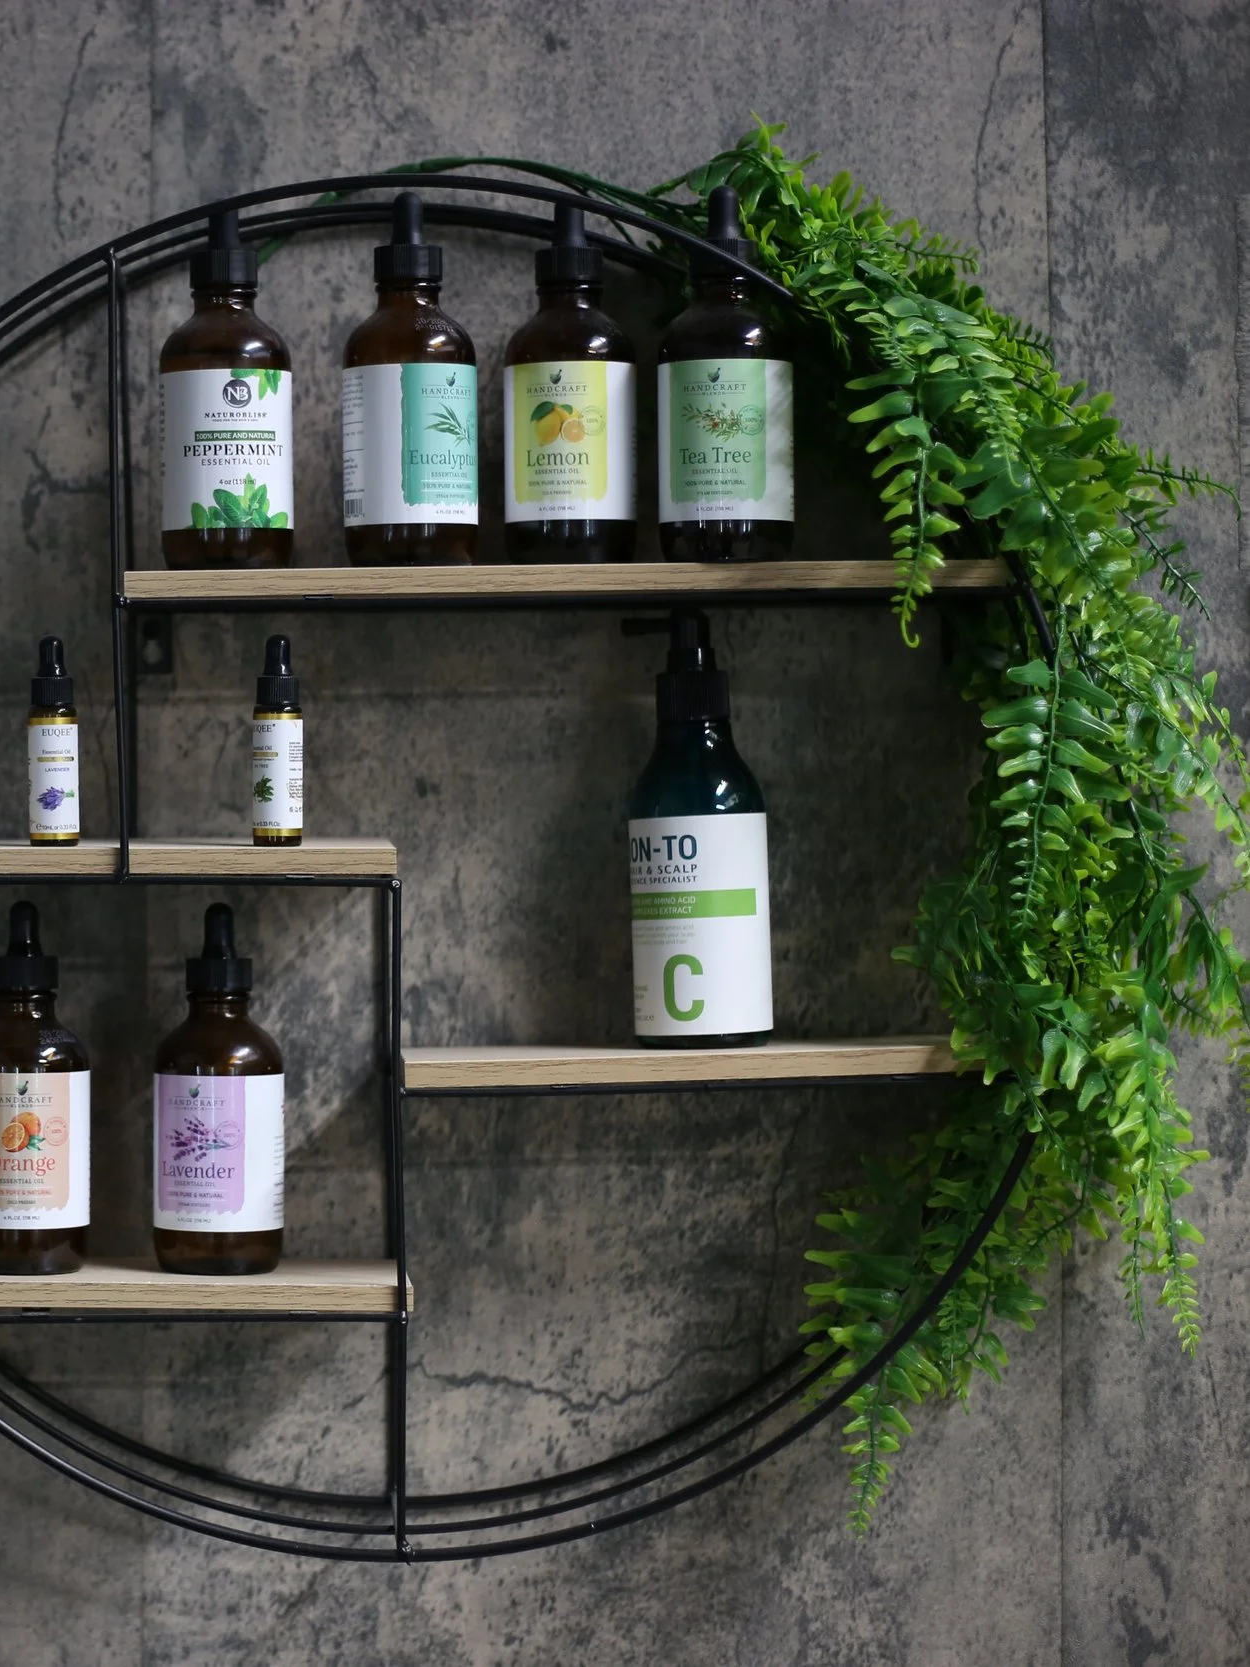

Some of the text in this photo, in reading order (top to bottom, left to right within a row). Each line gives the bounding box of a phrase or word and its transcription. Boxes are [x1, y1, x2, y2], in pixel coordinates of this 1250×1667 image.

[421, 387, 471, 397] HANDCRAFT
[526, 385, 588, 394] HANDCRAFT
[683, 384, 747, 393] HANDCRAFT
[214, 432, 232, 440] PURE
[248, 432, 275, 440] NATURAL
[183, 444, 283, 458] PEPPERMINT
[526, 450, 590, 467] Lemon
[679, 447, 752, 465] Tea Tree
[201, 458, 271, 466] ESSENTIAL OIL
[42, 728, 71, 737] EUQEE
[630, 834, 698, 863] ON-TO
[646, 866, 653, 875] &
[657, 864, 698, 875] SCALP
[649, 876, 698, 885] SPECIALIST
[654, 896, 676, 905] AMINO
[678, 896, 696, 904] ACID
[658, 906, 693, 915] EXTRACT
[662, 954, 705, 1022] C
[162, 1160, 236, 1179] Lavender
